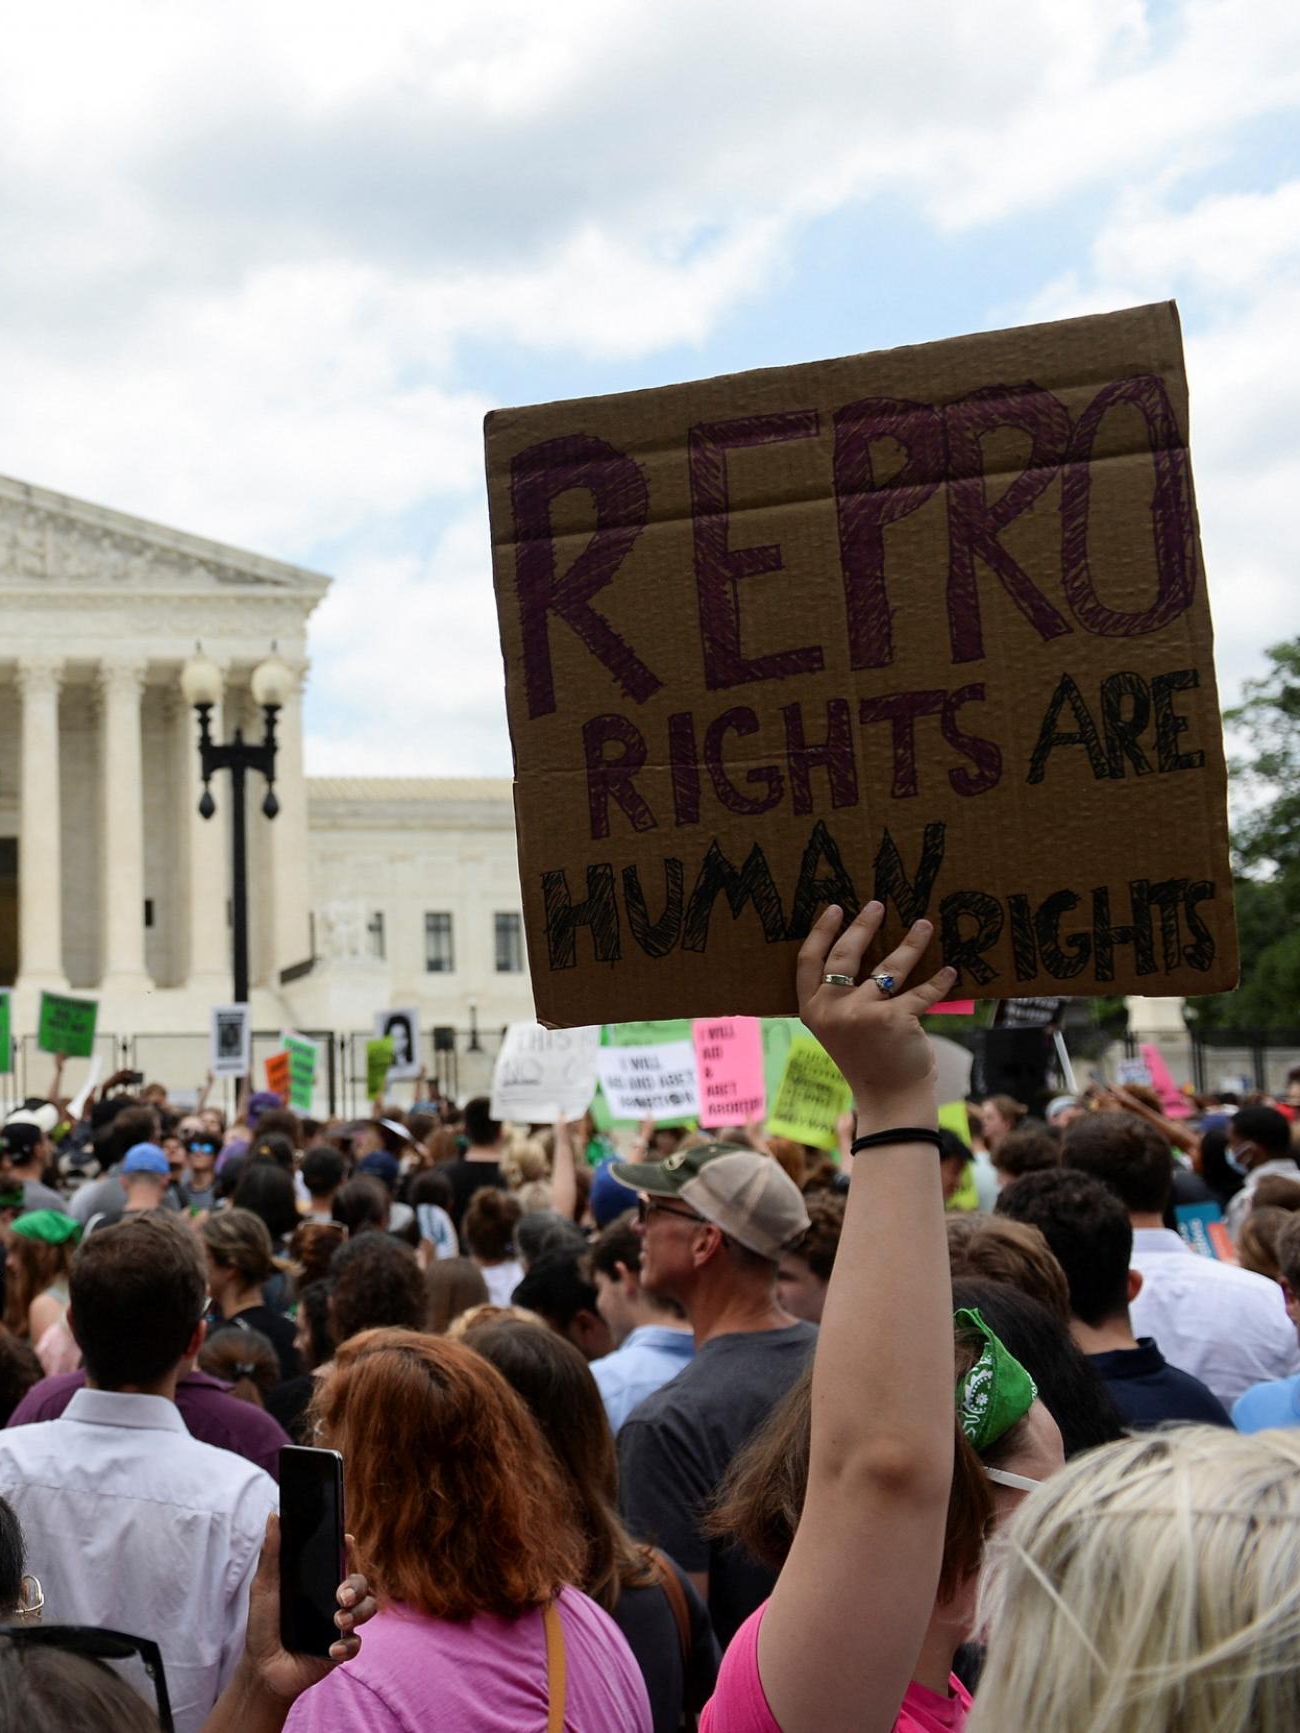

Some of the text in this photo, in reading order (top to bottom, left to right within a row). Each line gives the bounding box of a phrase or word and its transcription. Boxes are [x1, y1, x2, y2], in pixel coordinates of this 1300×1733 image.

[510, 373, 1196, 720] REPRO
[581, 669, 1207, 840] RIGHTS ARE
[541, 819, 1217, 987] HUMAN RIGHTS
